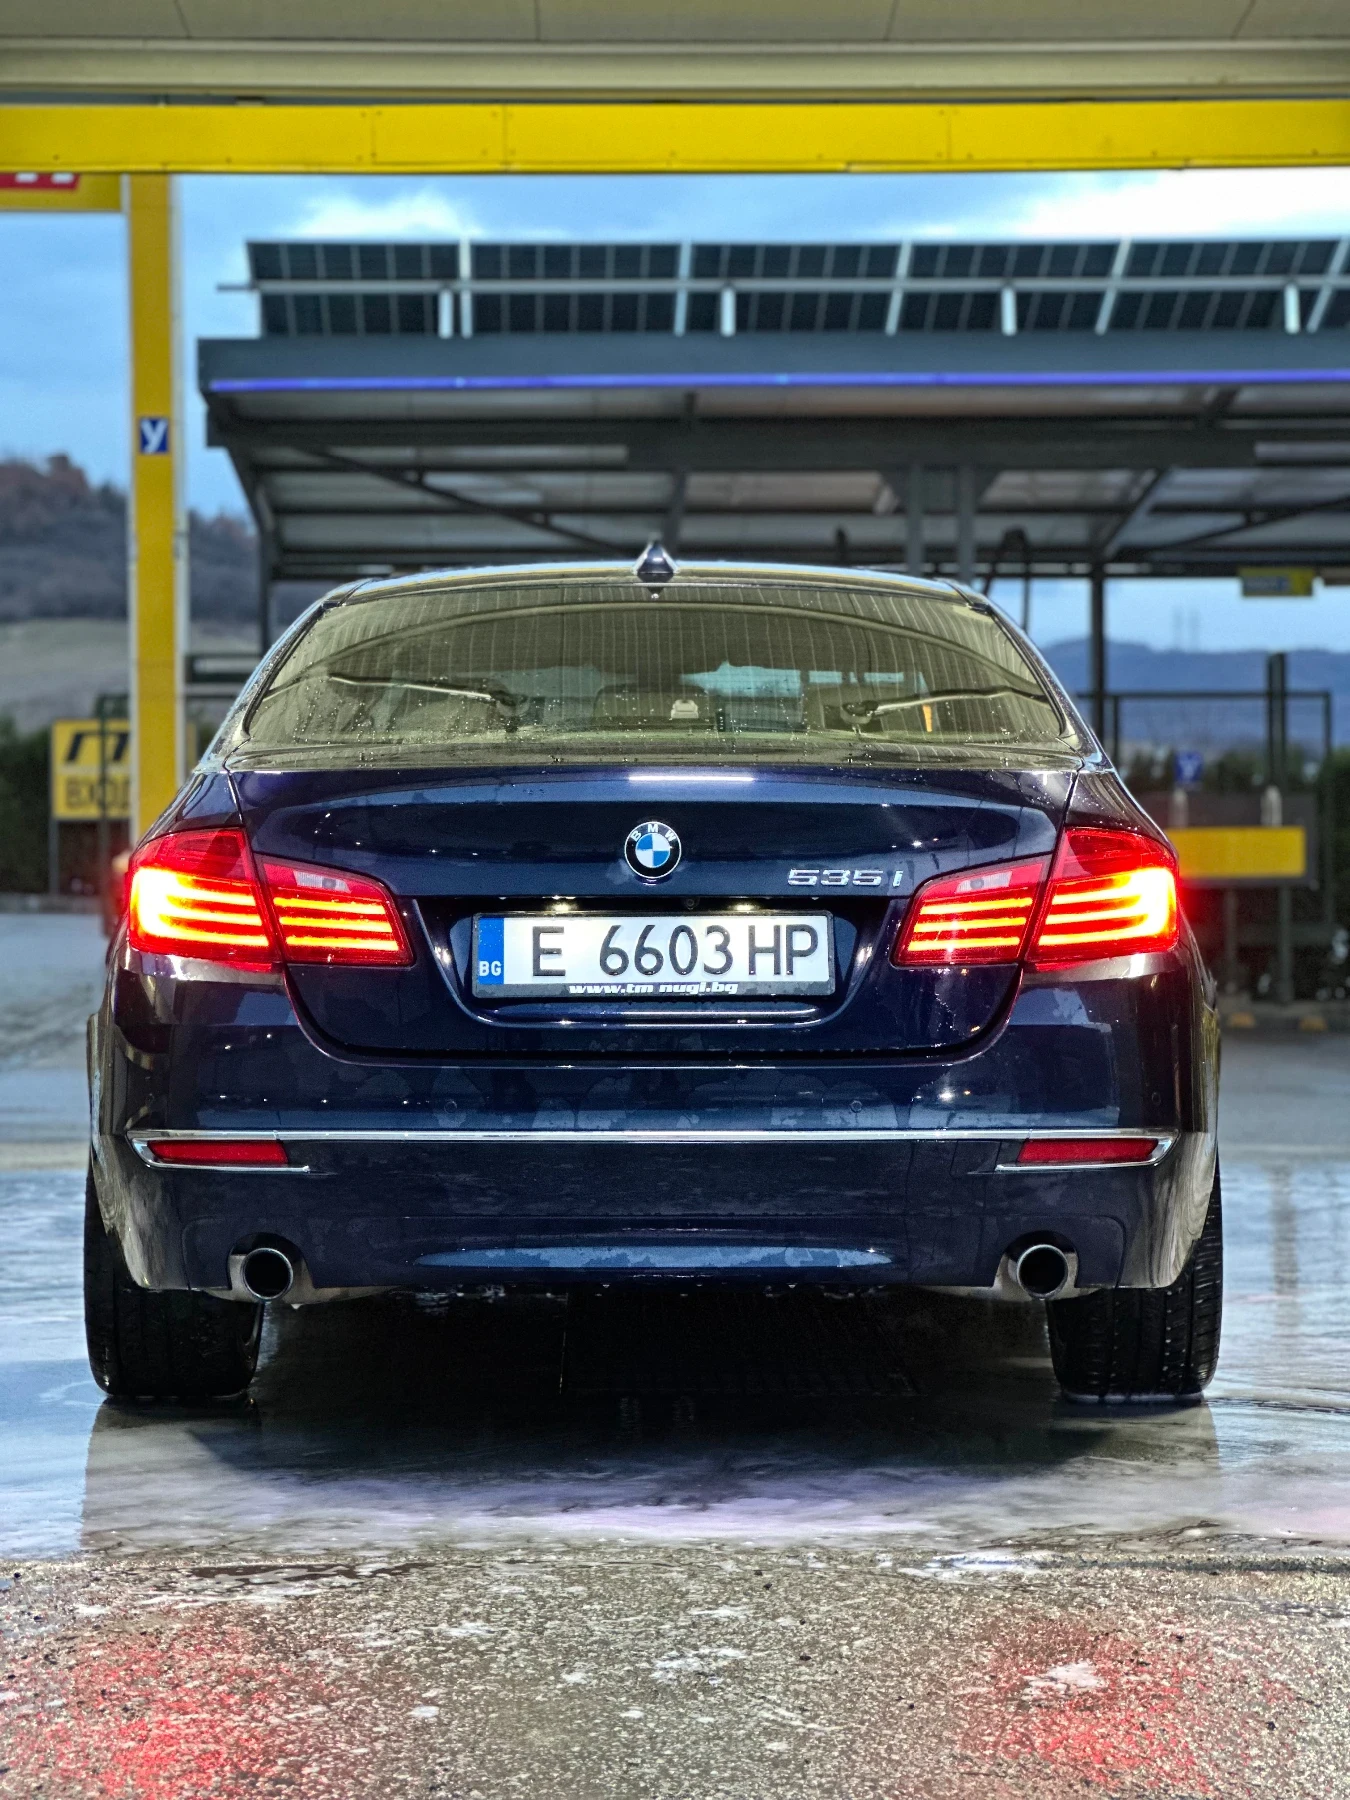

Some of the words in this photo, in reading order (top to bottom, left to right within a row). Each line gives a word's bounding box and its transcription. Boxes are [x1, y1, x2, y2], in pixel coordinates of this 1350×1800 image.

[629, 823, 677, 842] BMW
[532, 926, 566, 977] E
[599, 924, 734, 976] 6603
[748, 924, 819, 976] HP
[478, 960, 502, 977] BG
